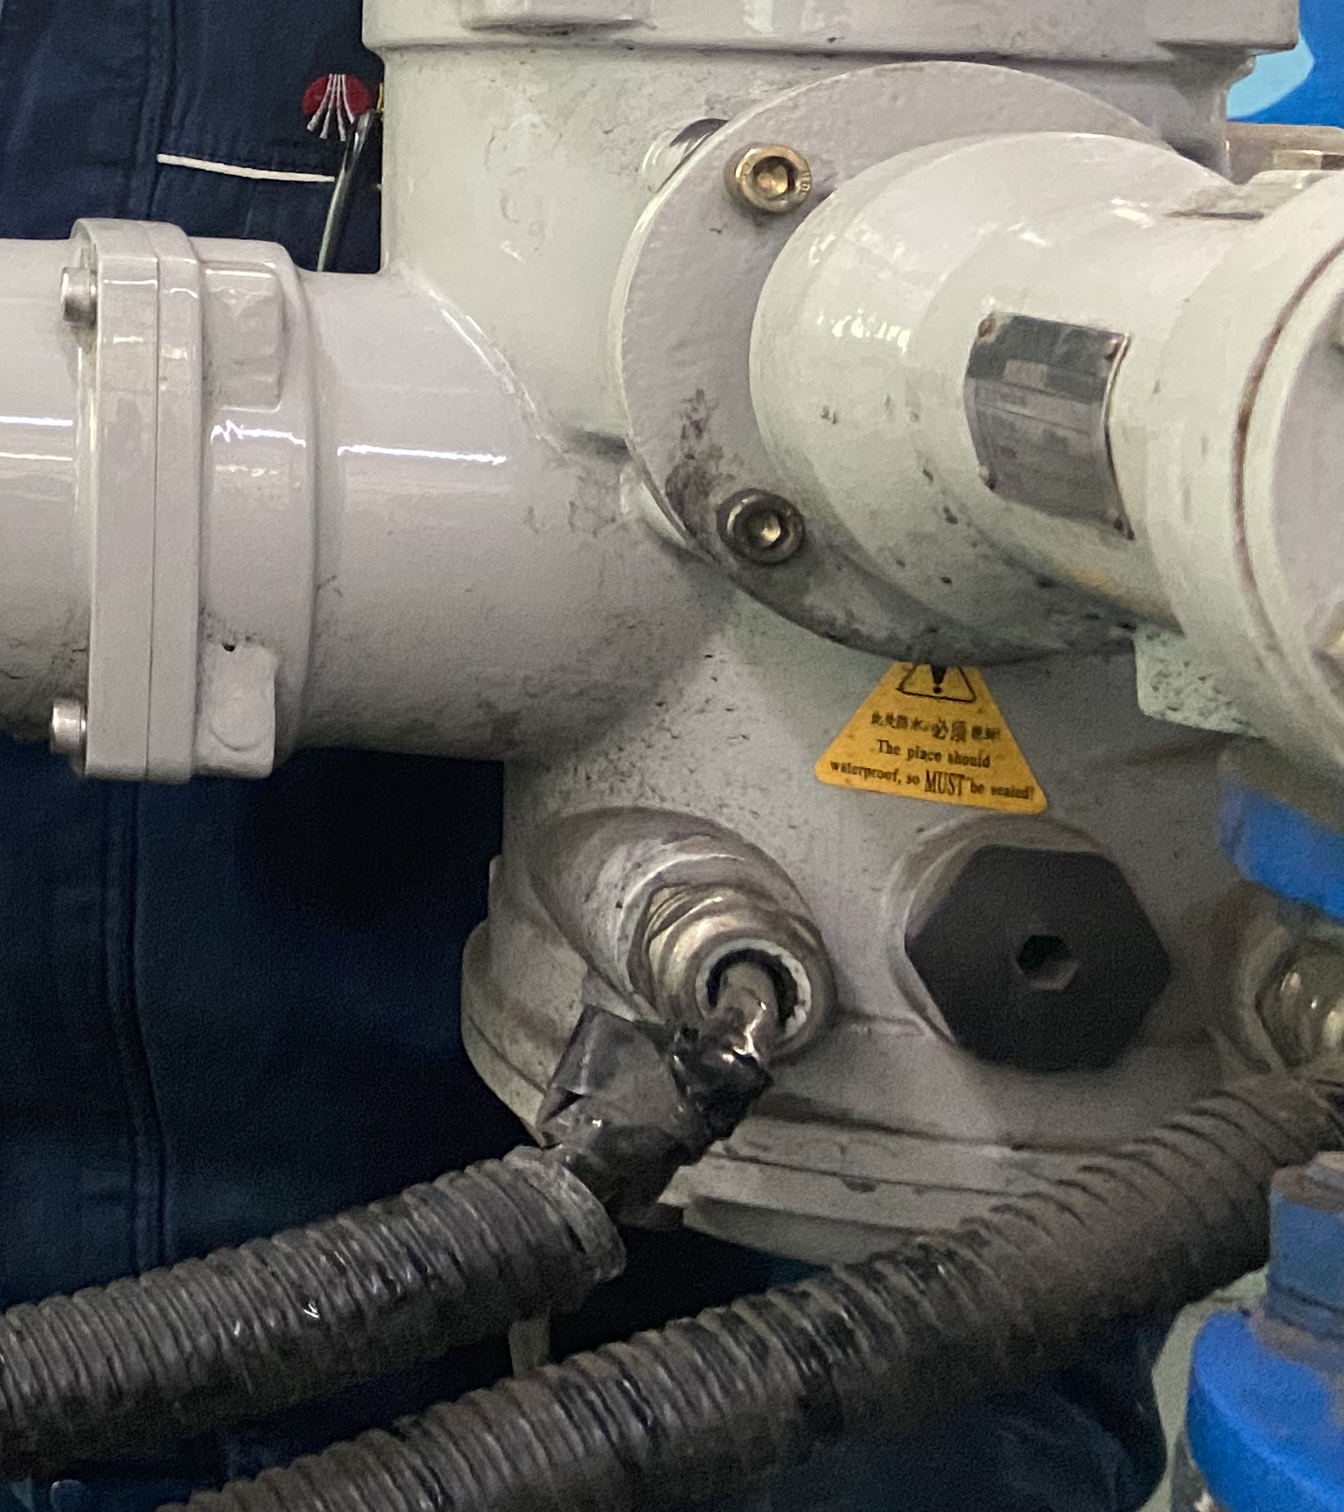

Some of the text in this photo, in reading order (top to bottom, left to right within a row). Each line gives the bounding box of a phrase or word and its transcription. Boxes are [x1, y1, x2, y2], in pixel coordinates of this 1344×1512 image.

[877, 739, 991, 768] The place should
[830, 760, 901, 785] waterproof,
[906, 774, 920, 785] so
[924, 769, 966, 797] MUST
